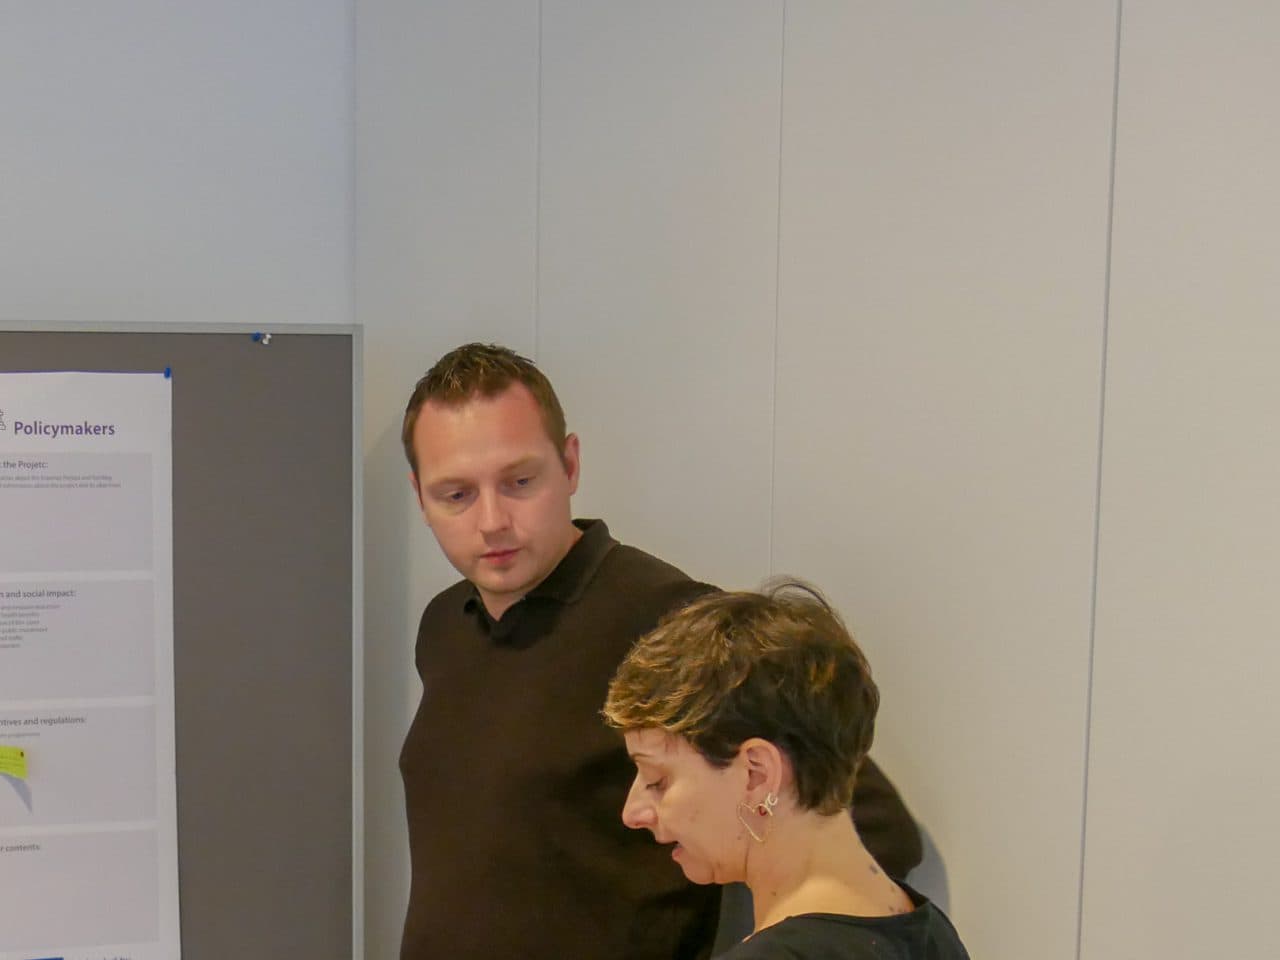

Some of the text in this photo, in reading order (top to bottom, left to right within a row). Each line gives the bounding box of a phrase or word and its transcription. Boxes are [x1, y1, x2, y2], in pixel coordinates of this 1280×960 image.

[14, 421, 115, 438] Policymakers
[3, 460, 16, 469] the
[6, 589, 21, 598] and
[23, 589, 45, 598] social
[23, 717, 39, 726] and
